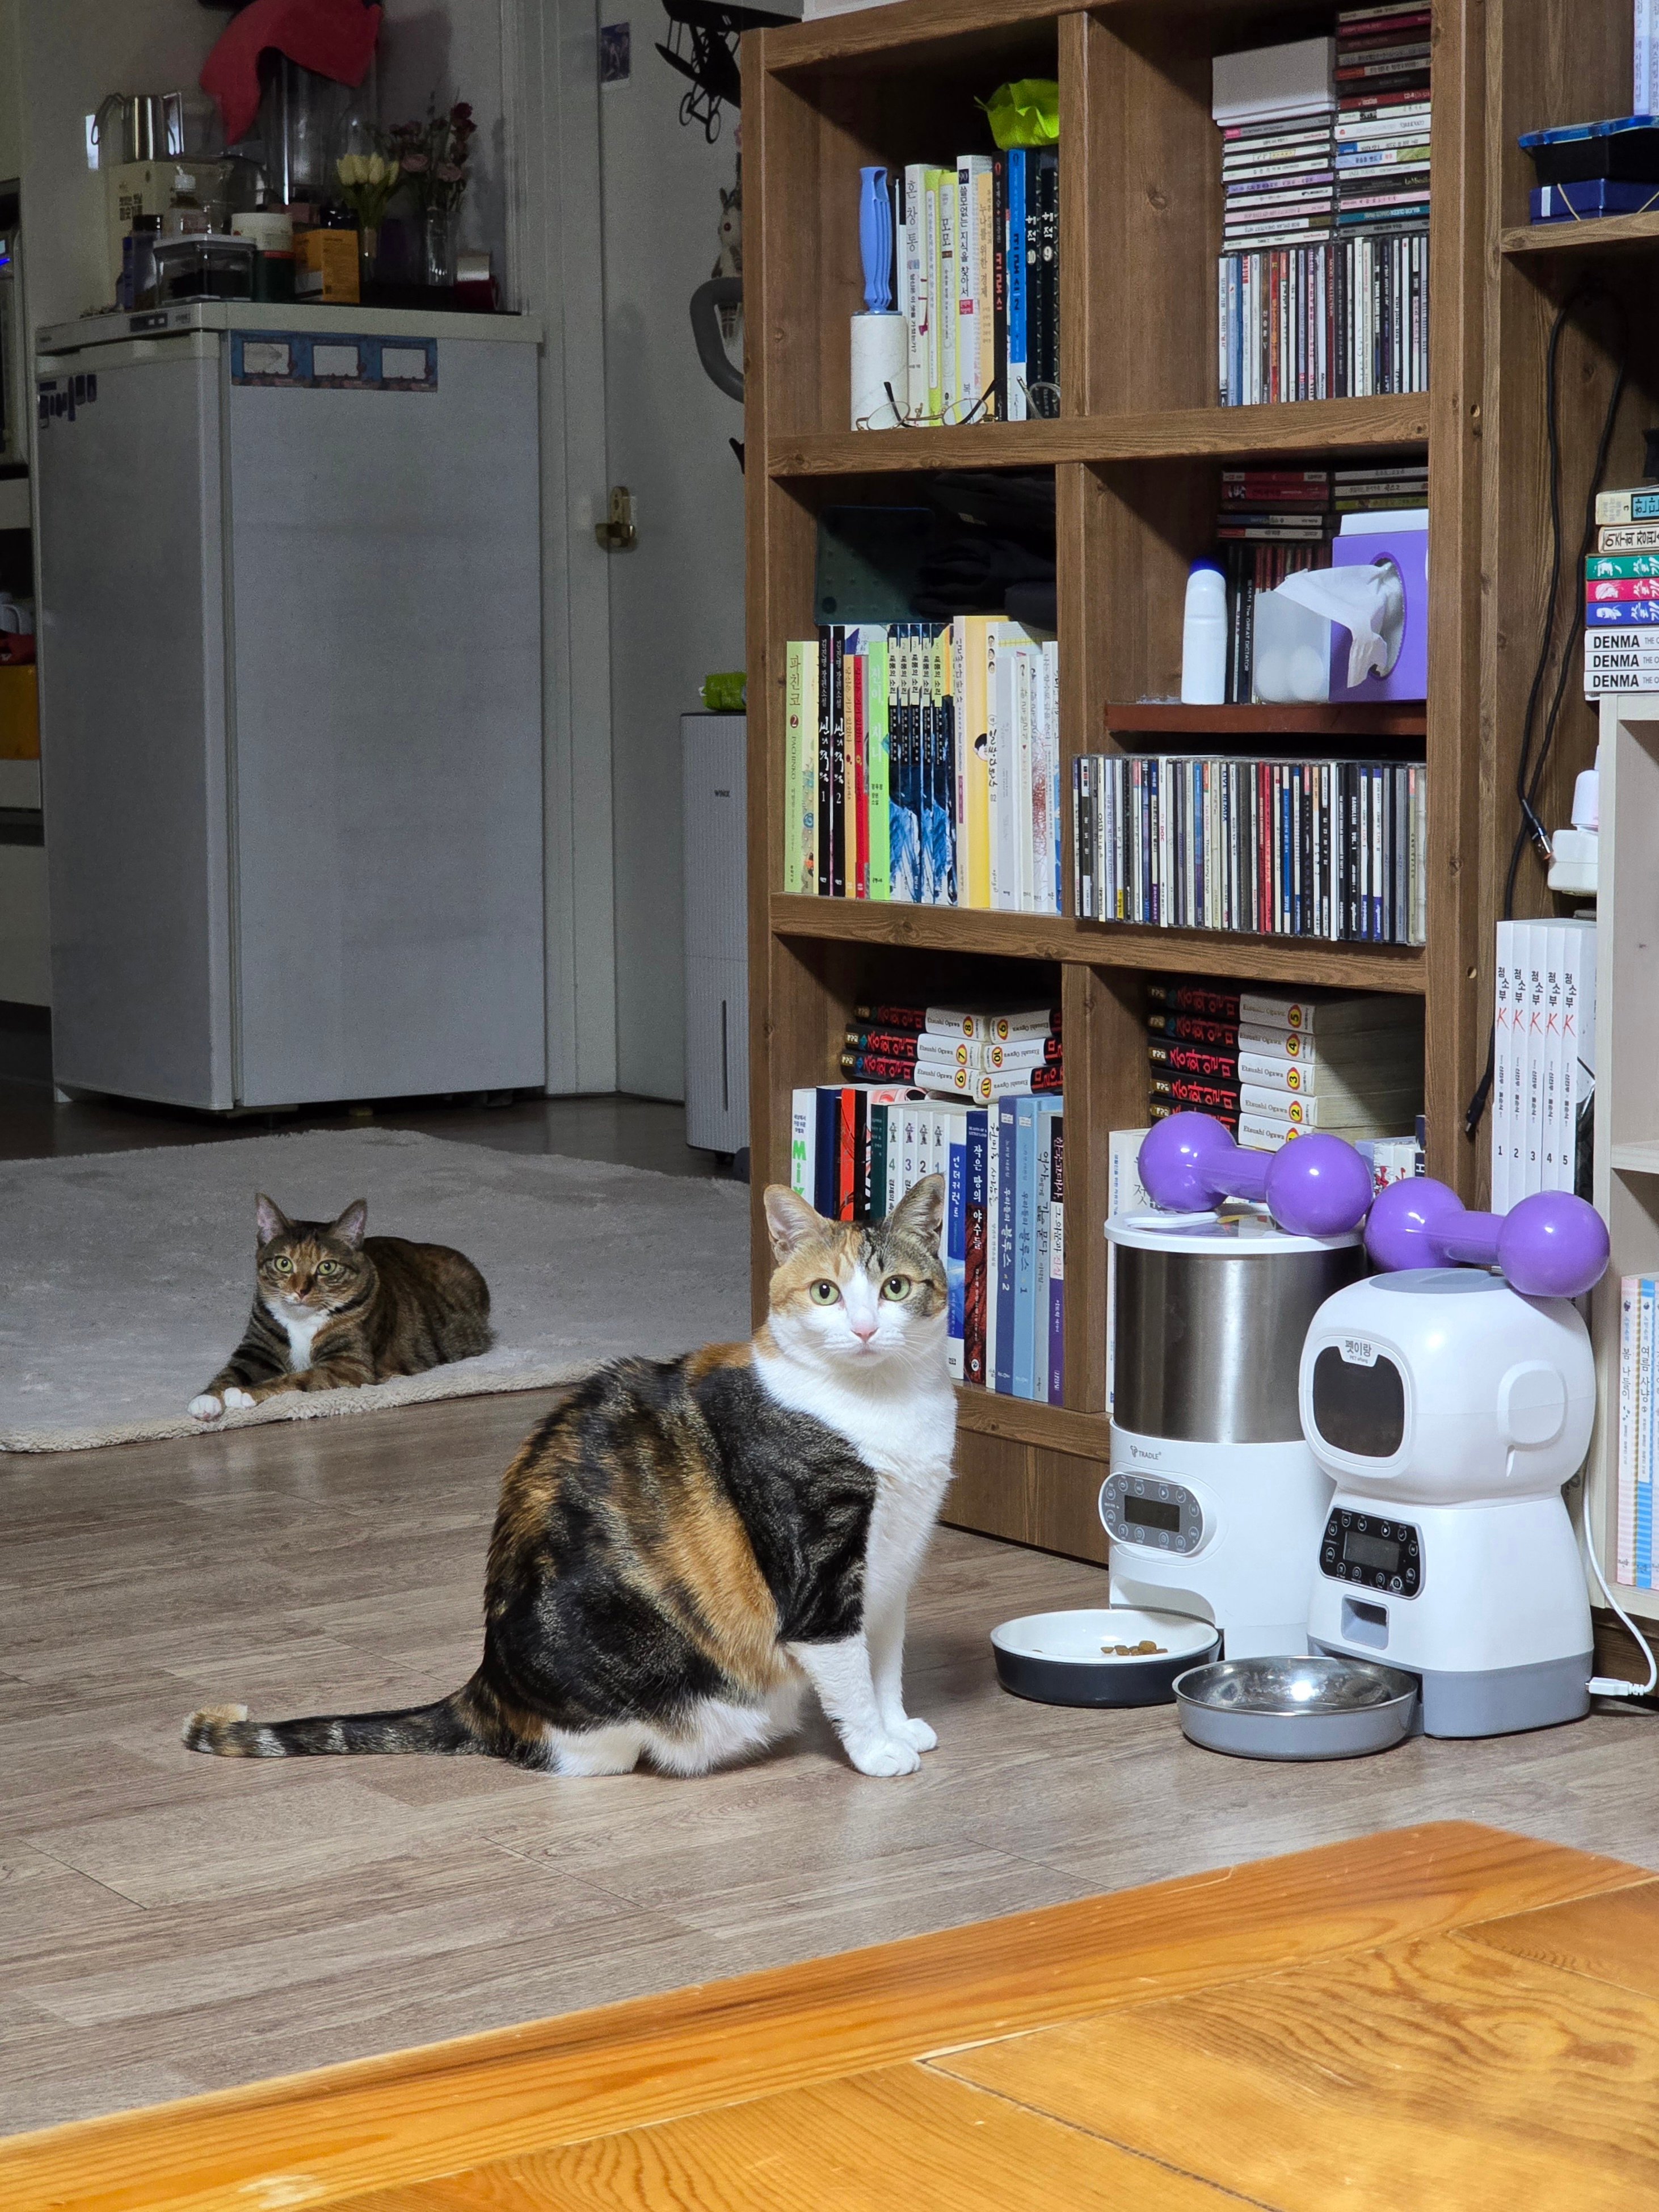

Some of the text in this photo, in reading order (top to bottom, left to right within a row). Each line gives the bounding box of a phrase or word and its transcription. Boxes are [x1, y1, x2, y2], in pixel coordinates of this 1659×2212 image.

[941, 218, 951, 247] 모모
[960, 232, 969, 262] 지식을
[961, 266, 969, 297] 찾아서
[1593, 635, 1640, 649] DENMA
[1593, 654, 1639, 667] DENMA
[790, 655, 801, 706] 파친코
[889, 679, 896, 694] 소리
[900, 680, 907, 695] 소리
[911, 678, 918, 693] 소리
[923, 680, 930, 695] 소리
[934, 680, 941, 695] 소리
[1593, 675, 1639, 687] DENMA
[791, 716, 798, 727] 2
[822, 791, 826, 802] 1
[836, 793, 841, 804] 2
[1266, 1008, 1286, 1017] Ogawa
[945, 1019, 960, 1028] Ogawa
[1012, 1024, 1029, 1032] Ogawa
[1261, 1036, 1281, 1045] Ogawa
[938, 1048, 953, 1056] Ogawa
[1169, 1047, 1236, 1078] 중화일미
[1497, 967, 1510, 1156] 청소부 K 1
[1513, 968, 1526, 1158] 청소부 K 2
[1529, 970, 1543, 1161] 청소부 K 3
[1546, 972, 1560, 1163] 청소부 K 4
[1563, 973, 1577, 1165] 청소부 K 5
[1264, 1069, 1284, 1078] Ogawa
[1172, 1080, 1237, 1109] 중화일미
[1267, 1104, 1287, 1115] Ogawa
[1243, 1125, 1285, 1142] Etsushi Ogawa
[889, 1158, 895, 1171] 4
[906, 1159, 911, 1171] 3
[920, 1160, 926, 1173] 2
[1038, 1151, 1049, 1196] 역사에게
[973, 1145, 982, 1250] 작은 땅의 야수들
[1055, 1206, 1061, 1218] 그
[1001, 1224, 1012, 1267] 블루스
[1037, 1227, 1048, 1256] 묻다
[1019, 1228, 1030, 1271] 블루스
[1052, 1256, 1062, 1276] 진실
[1345, 1340, 1371, 1357] 펫이랑
[1622, 1348, 1631, 1399] 봄 나들이
[1640, 1346, 1650, 1403] 여름 사냥
[1139, 1450, 1159, 1460] TRADLE
